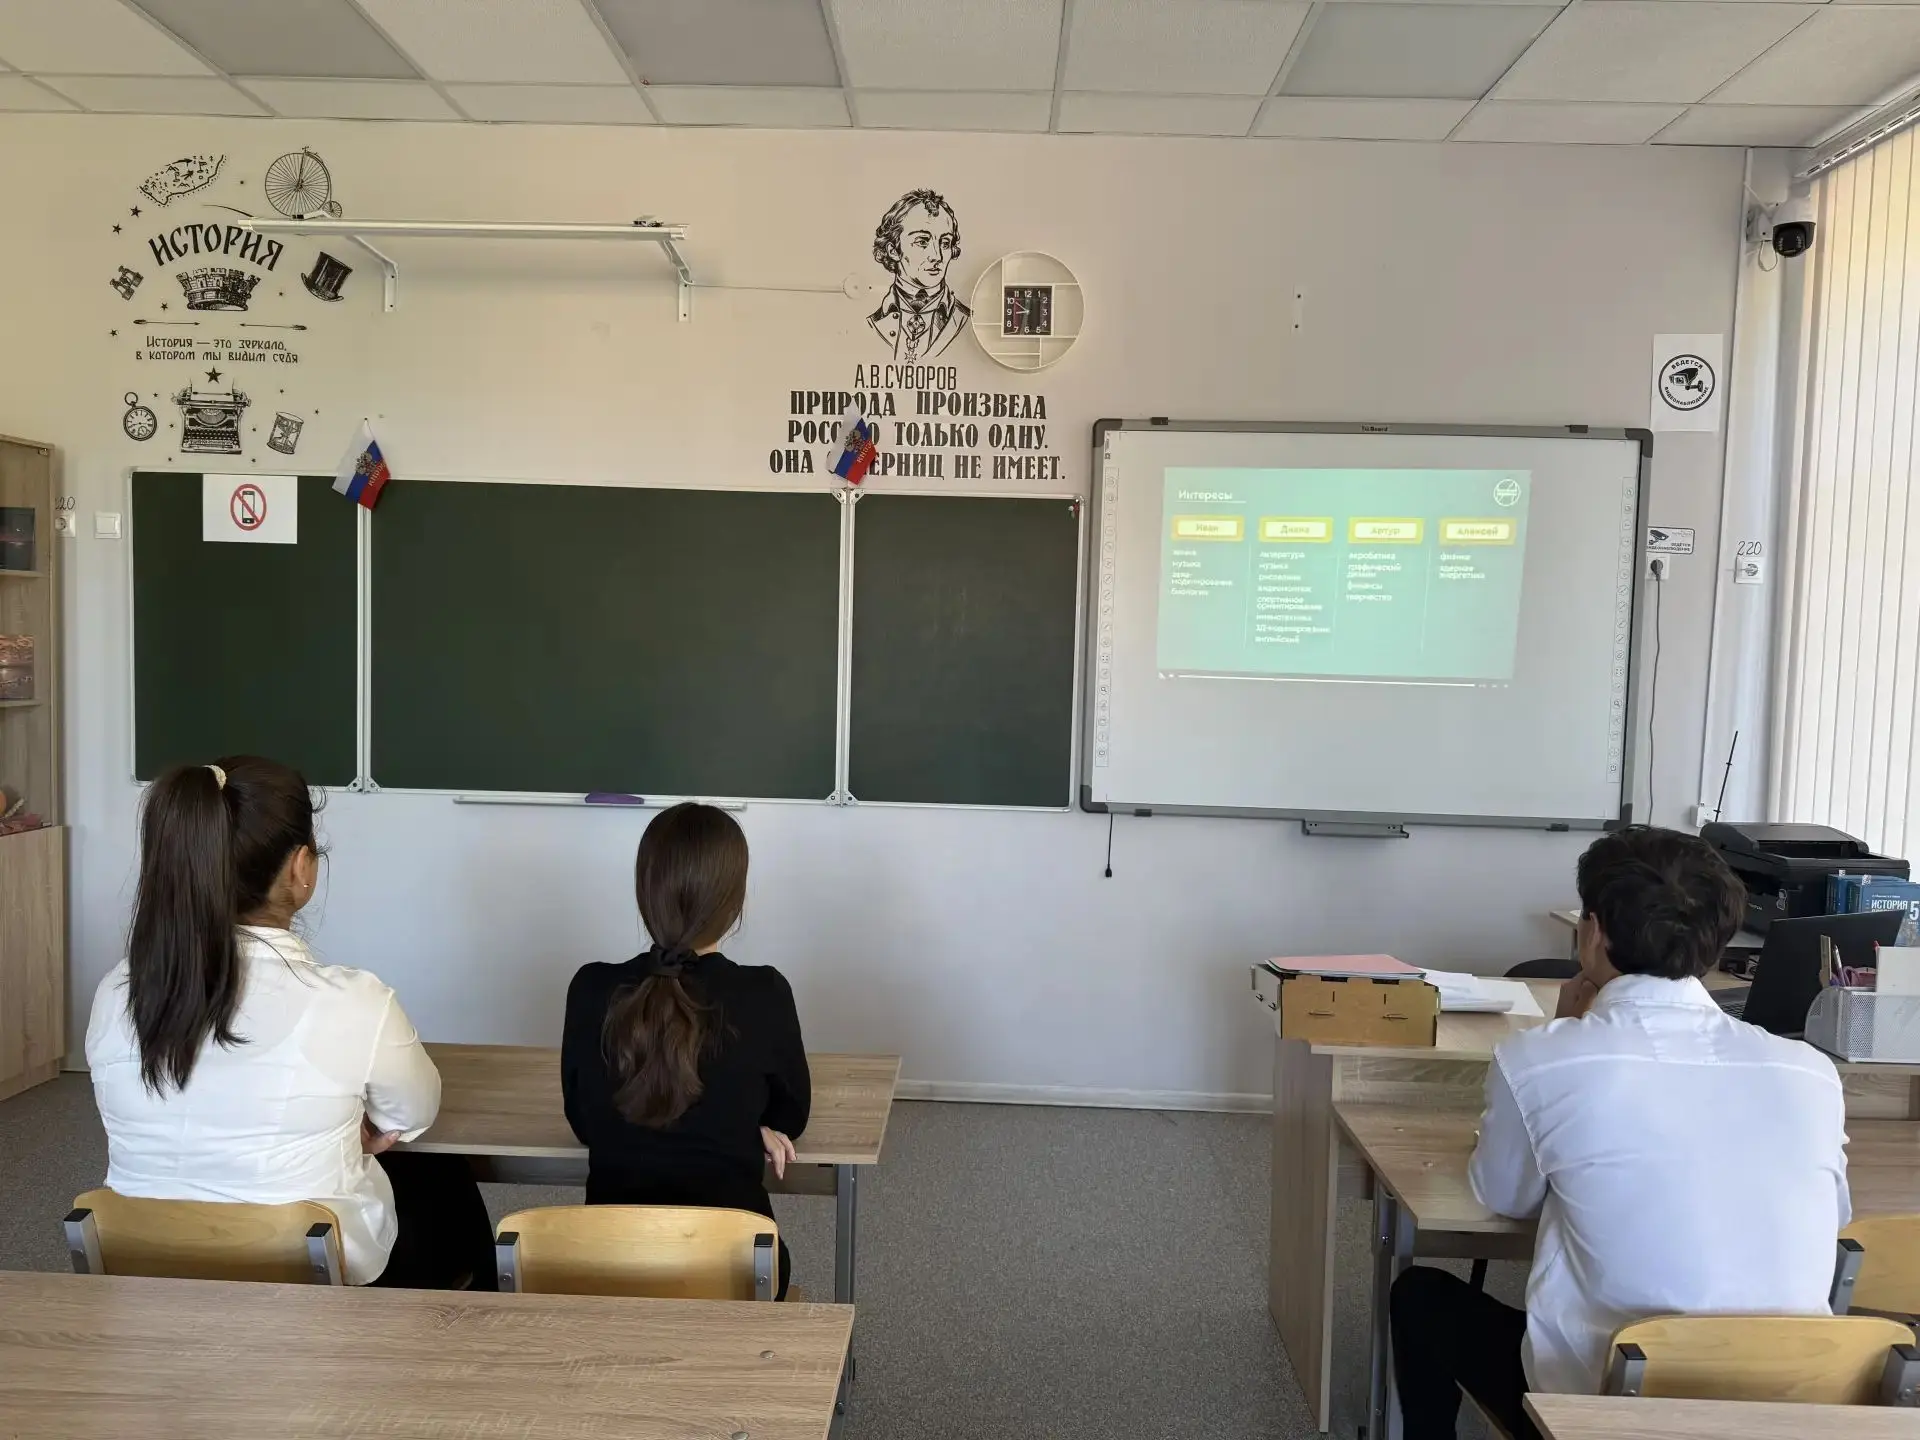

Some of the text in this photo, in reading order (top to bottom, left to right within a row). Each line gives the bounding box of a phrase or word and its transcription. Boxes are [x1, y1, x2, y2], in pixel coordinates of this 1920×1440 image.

[148, 223, 284, 271] ИСТОРИЯ
[146, 335, 193, 348] История
[214, 339, 232, 349] это
[238, 339, 287, 352] зеркало,
[136, 350, 298, 364] в котором мы видим себя
[1671, 360, 1704, 370] ВЕДЕТСЯ
[854, 364, 957, 390] А.В.СУВОРОВ
[1664, 386, 1710, 406] ВИДЕОНАБЛЮДЕНИЕ
[790, 390, 1048, 420] ПРИРОДА ПРОИЗВЕЛА
[788, 420, 1048, 452] РОСС ТОЛЬКО ОДНУ.
[769, 449, 814, 474] ОНА
[954, 454, 982, 480] НЕ
[992, 455, 1066, 480] ИМЕЕТ.
[1178, 490, 1233, 502] Интересы
[1196, 524, 1219, 533] Иван
[1280, 524, 1310, 534] Диана
[1456, 526, 1498, 536] Алексей
[1737, 540, 1762, 556] 220
[1871, 900, 1920, 920] ИСТОРИЯ 5
